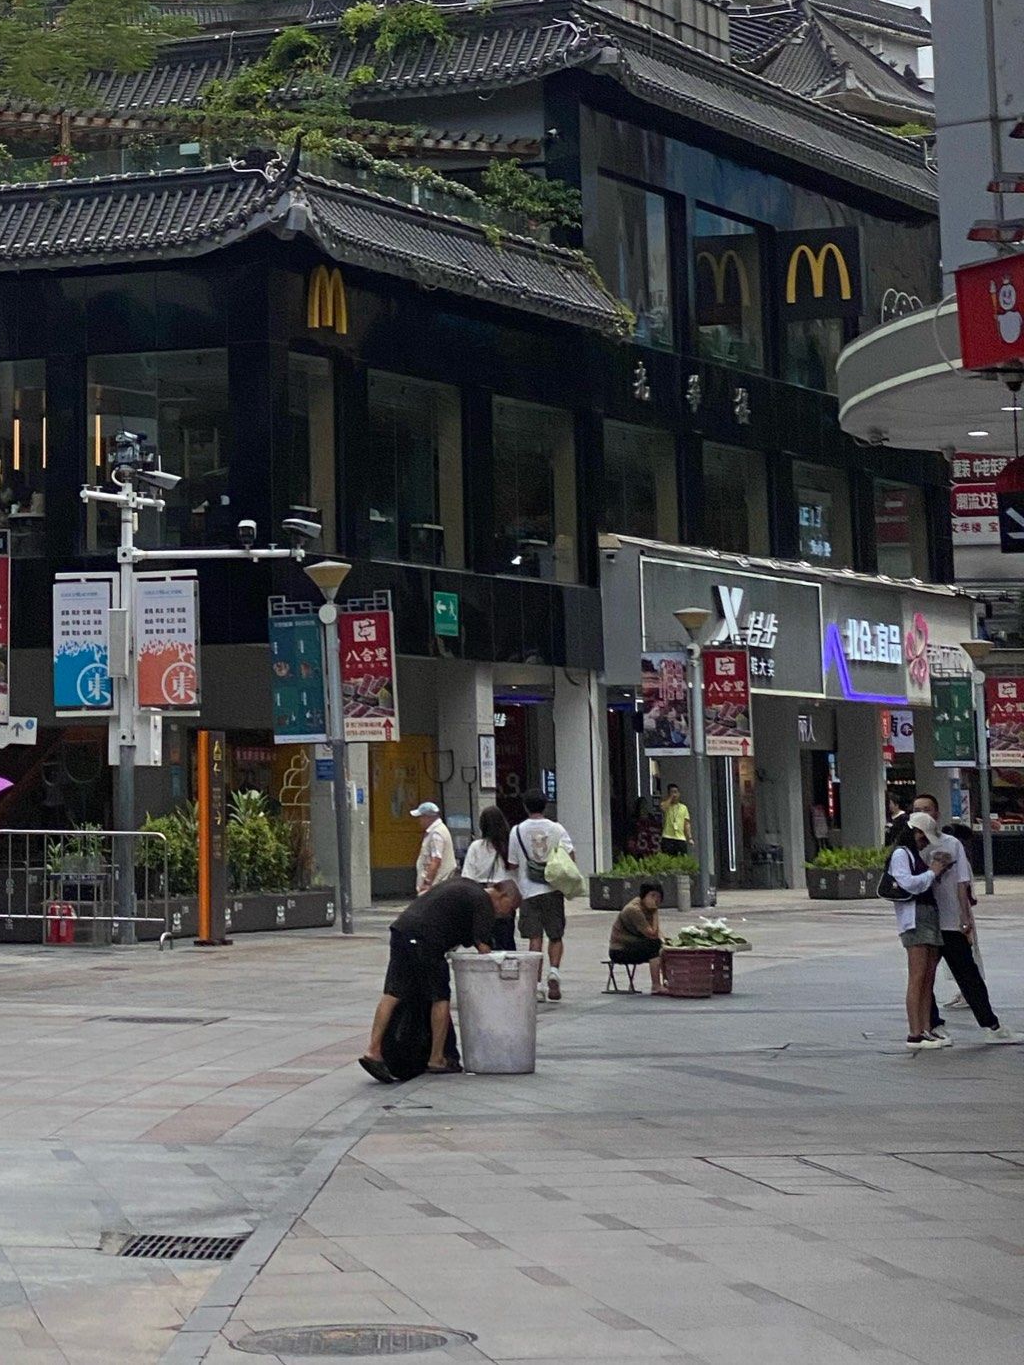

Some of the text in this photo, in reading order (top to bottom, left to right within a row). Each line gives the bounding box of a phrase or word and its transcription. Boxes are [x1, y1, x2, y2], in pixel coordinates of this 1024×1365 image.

[345, 647, 388, 662] 八合里
[708, 680, 745, 692] 八合里
